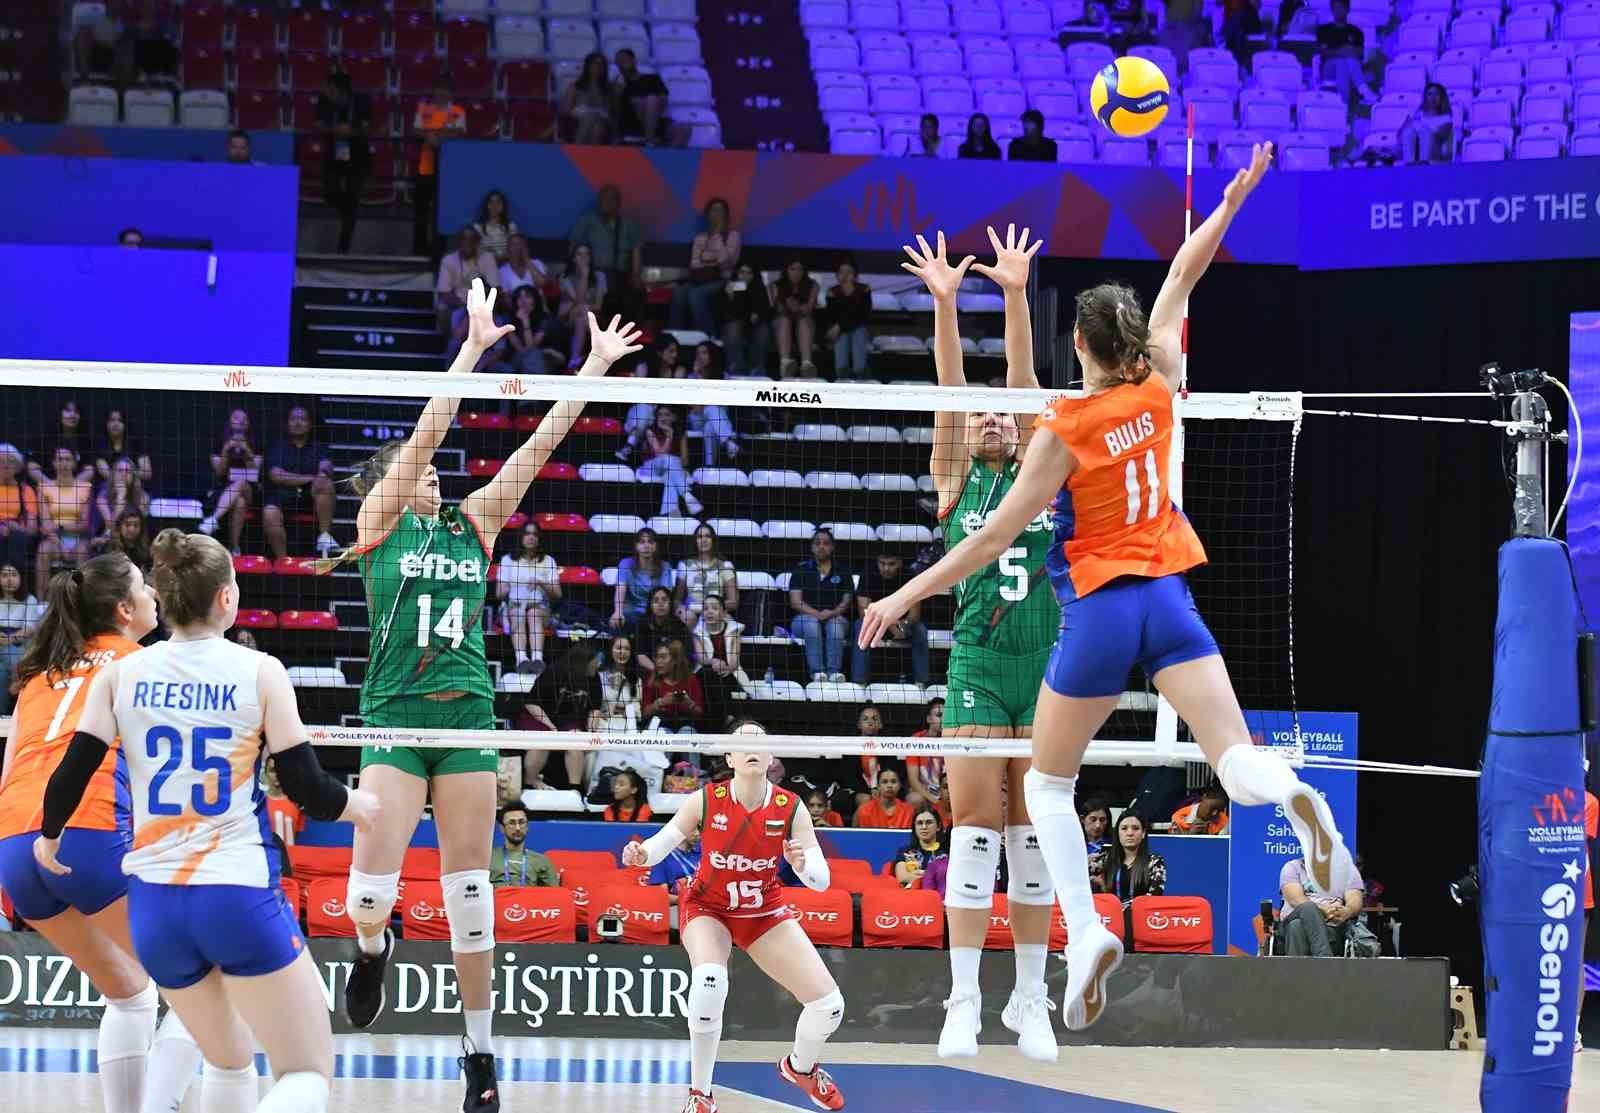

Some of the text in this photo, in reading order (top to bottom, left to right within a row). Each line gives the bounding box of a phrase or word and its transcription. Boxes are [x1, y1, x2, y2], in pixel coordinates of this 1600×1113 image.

[1370, 203, 1403, 230] BE
[1412, 198, 1481, 228] PART
[1488, 196, 1526, 224] OF
[1534, 193, 1587, 221] THE
[223, 369, 251, 388] VNL
[499, 377, 528, 395] VNL
[1103, 411, 1156, 457] BUIJS
[1124, 448, 1160, 525] 11
[998, 547, 1029, 601] 5
[416, 594, 465, 649] 14
[133, 682, 237, 711] REESINK
[962, 690, 975, 708] 5
[44, 676, 85, 742] 7
[330, 732, 393, 740] VOLLEYBALL
[608, 738, 670, 746] VOLLEYBALL
[1272, 732, 1344, 743] VOLEYBALL
[880, 742, 942, 751] VOLLEYBALL
[1311, 743, 1344, 751] LEAGUE
[145, 725, 233, 817] 25
[1528, 826, 1584, 837] VOLLEYBALL
[709, 851, 777, 872] efbet
[726, 880, 764, 910] 15
[529, 909, 561, 919] TVF
[632, 911, 664, 922] TVF
[806, 911, 838, 922] TVF
[902, 915, 935, 925] TVF
[990, 917, 1009, 926] TV
[1171, 917, 1201, 927] TVF
[394, 952, 690, 1028] DEİŞTİRİR
[1532, 923, 1569, 1056] Senoh
